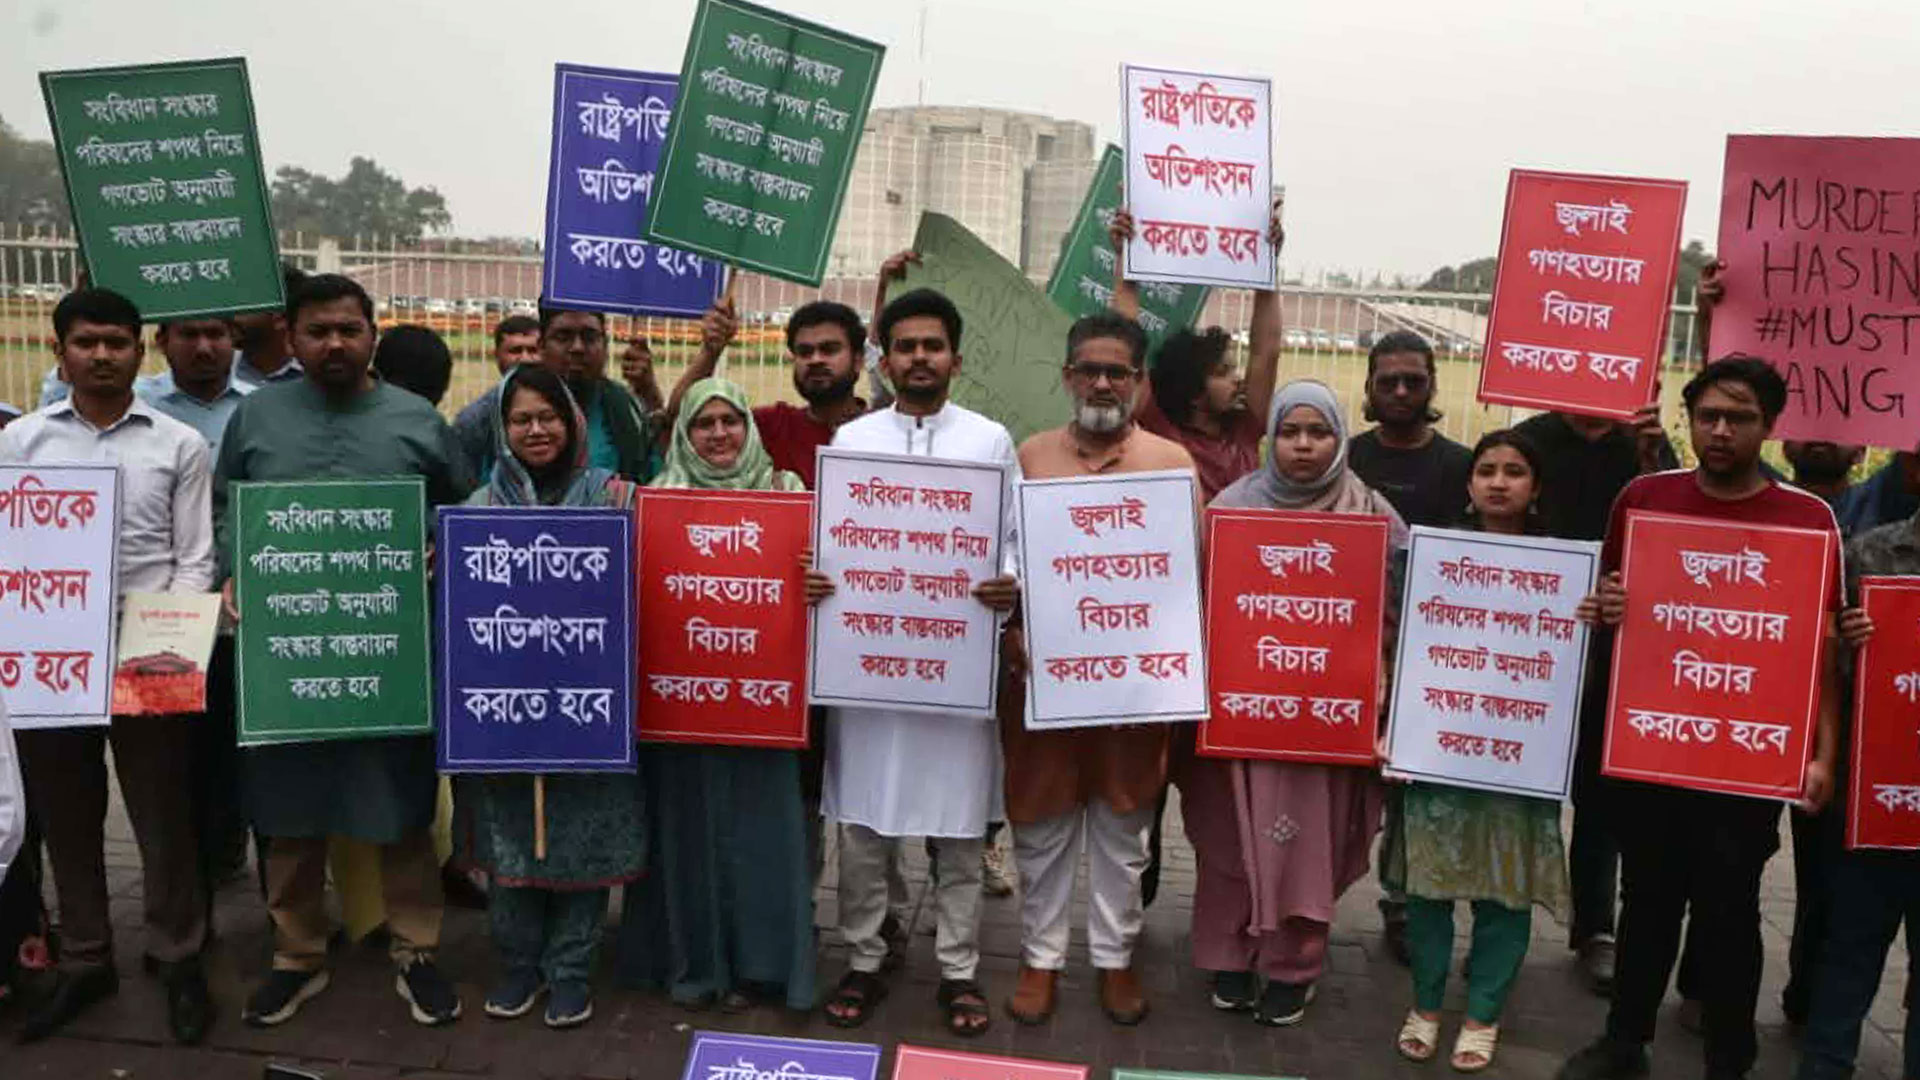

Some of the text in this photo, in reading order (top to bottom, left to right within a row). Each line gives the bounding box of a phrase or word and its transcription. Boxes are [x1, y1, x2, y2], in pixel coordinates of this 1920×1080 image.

[578, 93, 671, 142] রাষ্ট্রপতি
[1140, 79, 1256, 128] রাষ্ট্রপতিকে
[577, 159, 654, 203] অভিশ
[1144, 144, 1255, 196] অভিশংসন
[1556, 200, 1632, 235] জুলাই
[568, 233, 648, 269] করতে
[1139, 219, 1261, 263] করতে হবে
[1529, 248, 1645, 284] গণহত্যার
[1763, 241, 1920, 303] HASIN
[1542, 290, 1613, 330] বিচার
[1754, 306, 1920, 355] #MUST
[1502, 342, 1642, 381] করতে হবে
[1770, 360, 1905, 420] ANG
[0, 475, 98, 529] পতিকে
[847, 478, 972, 512] সংবিধান সংস্কার
[267, 504, 392, 533] সংবিধান সংস্কার
[1068, 496, 1146, 537] জুলাই
[686, 518, 763, 557] জুলাই
[829, 521, 901, 550] পরিষদের
[907, 531, 947, 553] শপথ
[250, 546, 323, 573] পরিষদের
[328, 550, 370, 571] শপথ
[463, 534, 609, 586] রাষ্ট্রপতিকে
[1052, 553, 1170, 582] গণহত্যার
[1258, 539, 1336, 577] জুলাই
[1439, 557, 1562, 595] সংবিধান সংস্কার
[1680, 547, 1770, 588] জুলাই
[665, 573, 784, 604] গণহত্যার
[844, 566, 906, 592] গণভোট
[267, 589, 331, 615] গণভোট
[1077, 597, 1151, 631] বিচার
[1237, 593, 1355, 624] গণহত্যার
[1418, 598, 1488, 629] পরিষদের
[1492, 611, 1532, 634] শপথ
[467, 604, 607, 654] অভিশংসন
[685, 617, 759, 654] বিচার
[843, 612, 895, 635] সংস্কার
[1653, 602, 1789, 641] গণহত্যার
[268, 636, 323, 659] সংস্কার
[1257, 636, 1329, 672] বিচার
[1428, 645, 1489, 671] গণভোট
[32, 651, 93, 693] হবে
[860, 655, 947, 682] করতে হবে
[1044, 653, 1189, 682] করতে হবে
[1672, 650, 1757, 693] বিচার
[290, 676, 380, 699] করতে হবে
[648, 675, 792, 706] করতে হবে
[1424, 688, 1476, 713] সংস্কার
[462, 688, 613, 725] করতে হবে
[1219, 693, 1362, 724] করতে হবে
[1438, 731, 1523, 762] করতে হবে
[1628, 709, 1791, 754] করতে হবে
